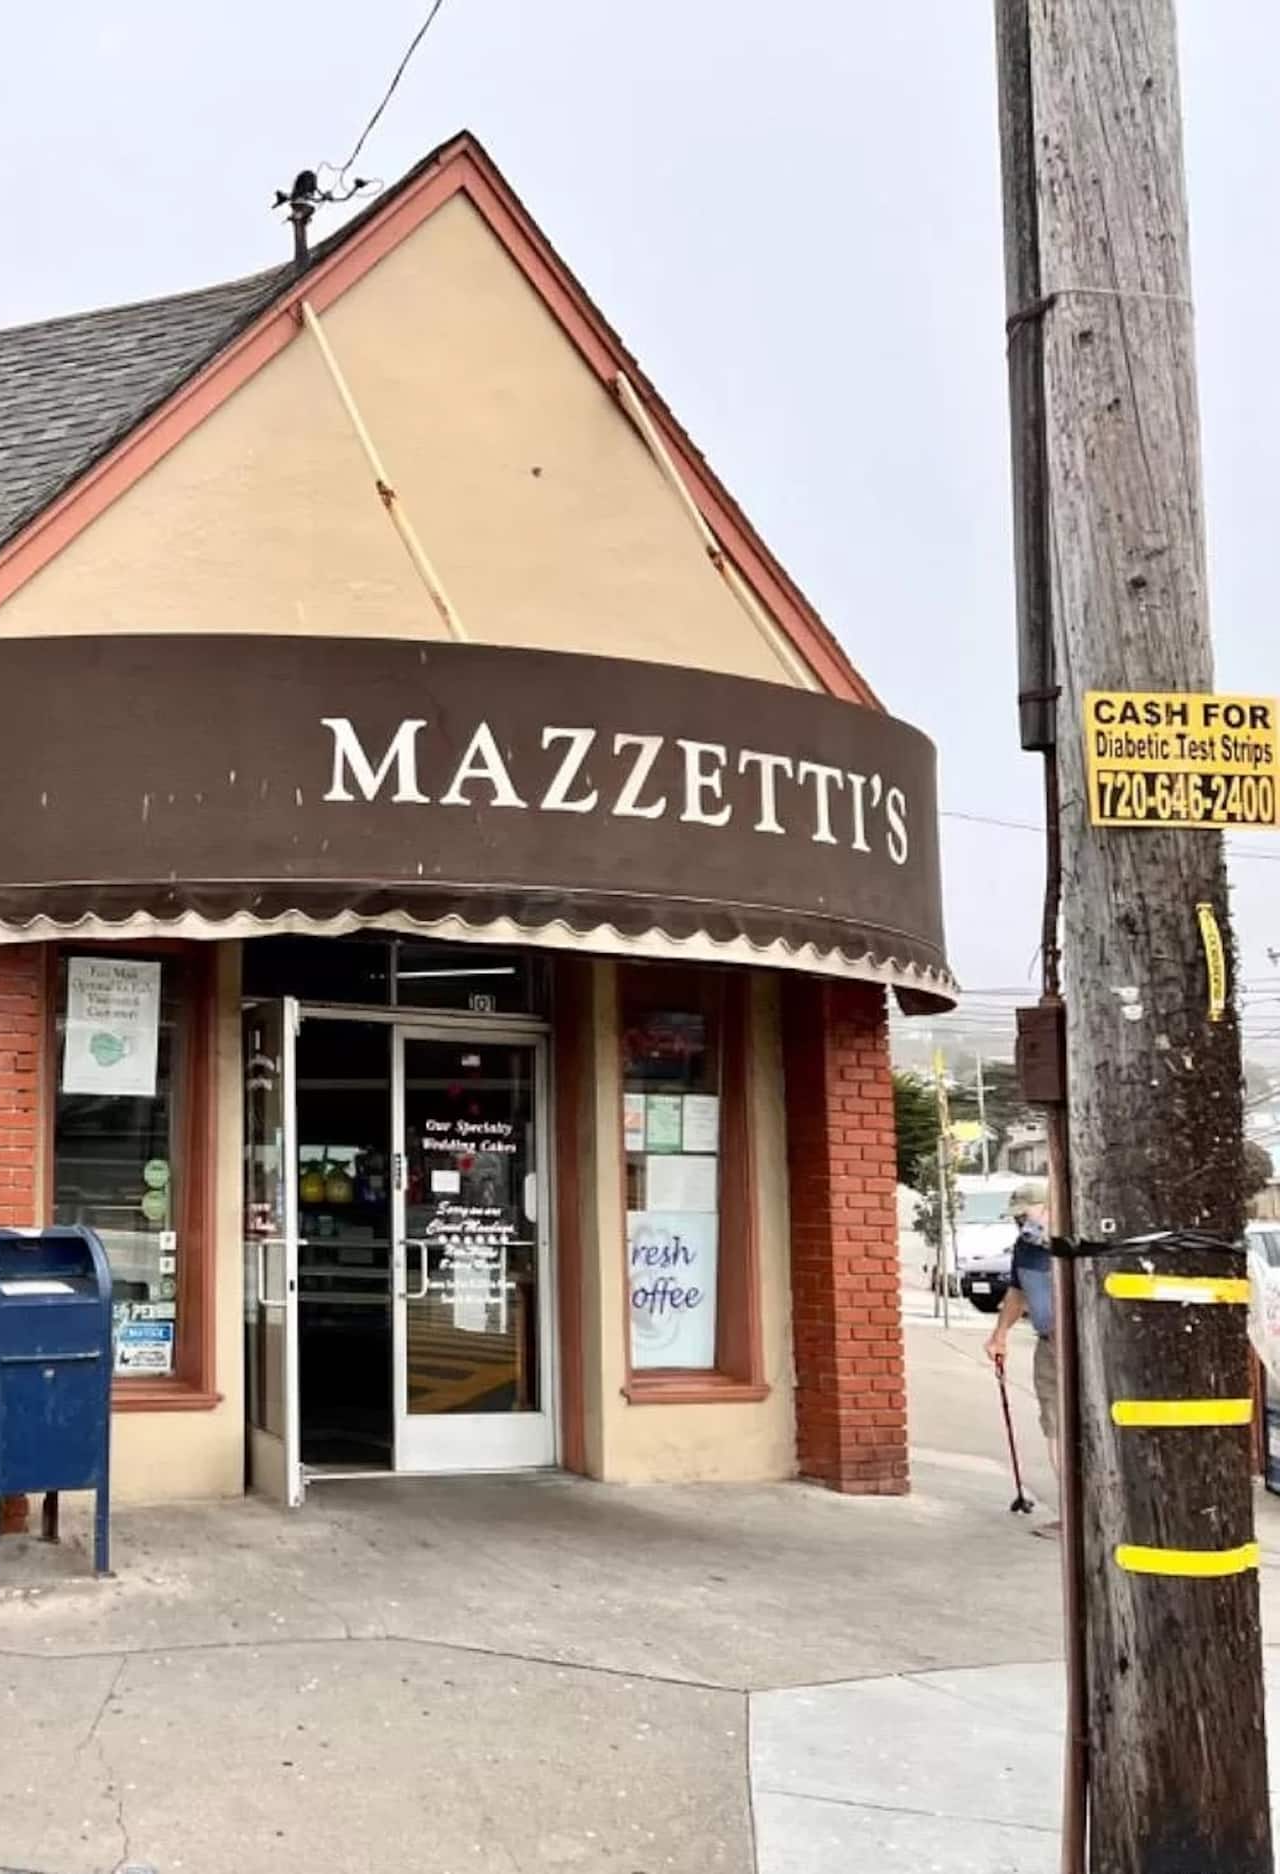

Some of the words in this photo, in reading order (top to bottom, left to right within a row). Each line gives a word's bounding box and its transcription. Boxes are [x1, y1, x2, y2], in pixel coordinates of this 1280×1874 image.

[1203, 703, 1271, 730] FOR
[1096, 729, 1170, 760] Diabetic
[1175, 733, 1216, 762] Test
[1221, 733, 1274, 770] Strips
[320, 717, 909, 866] MAZZETTI'S
[1098, 770, 1274, 823] 720-646-2400
[422, 1137, 476, 1154] Wedding
[480, 1139, 517, 1152] Cakes
[425, 1119, 453, 1132] Our
[455, 1119, 513, 1136] Specialty
[632, 1235, 697, 1268] resh
[632, 1276, 705, 1315] offee
